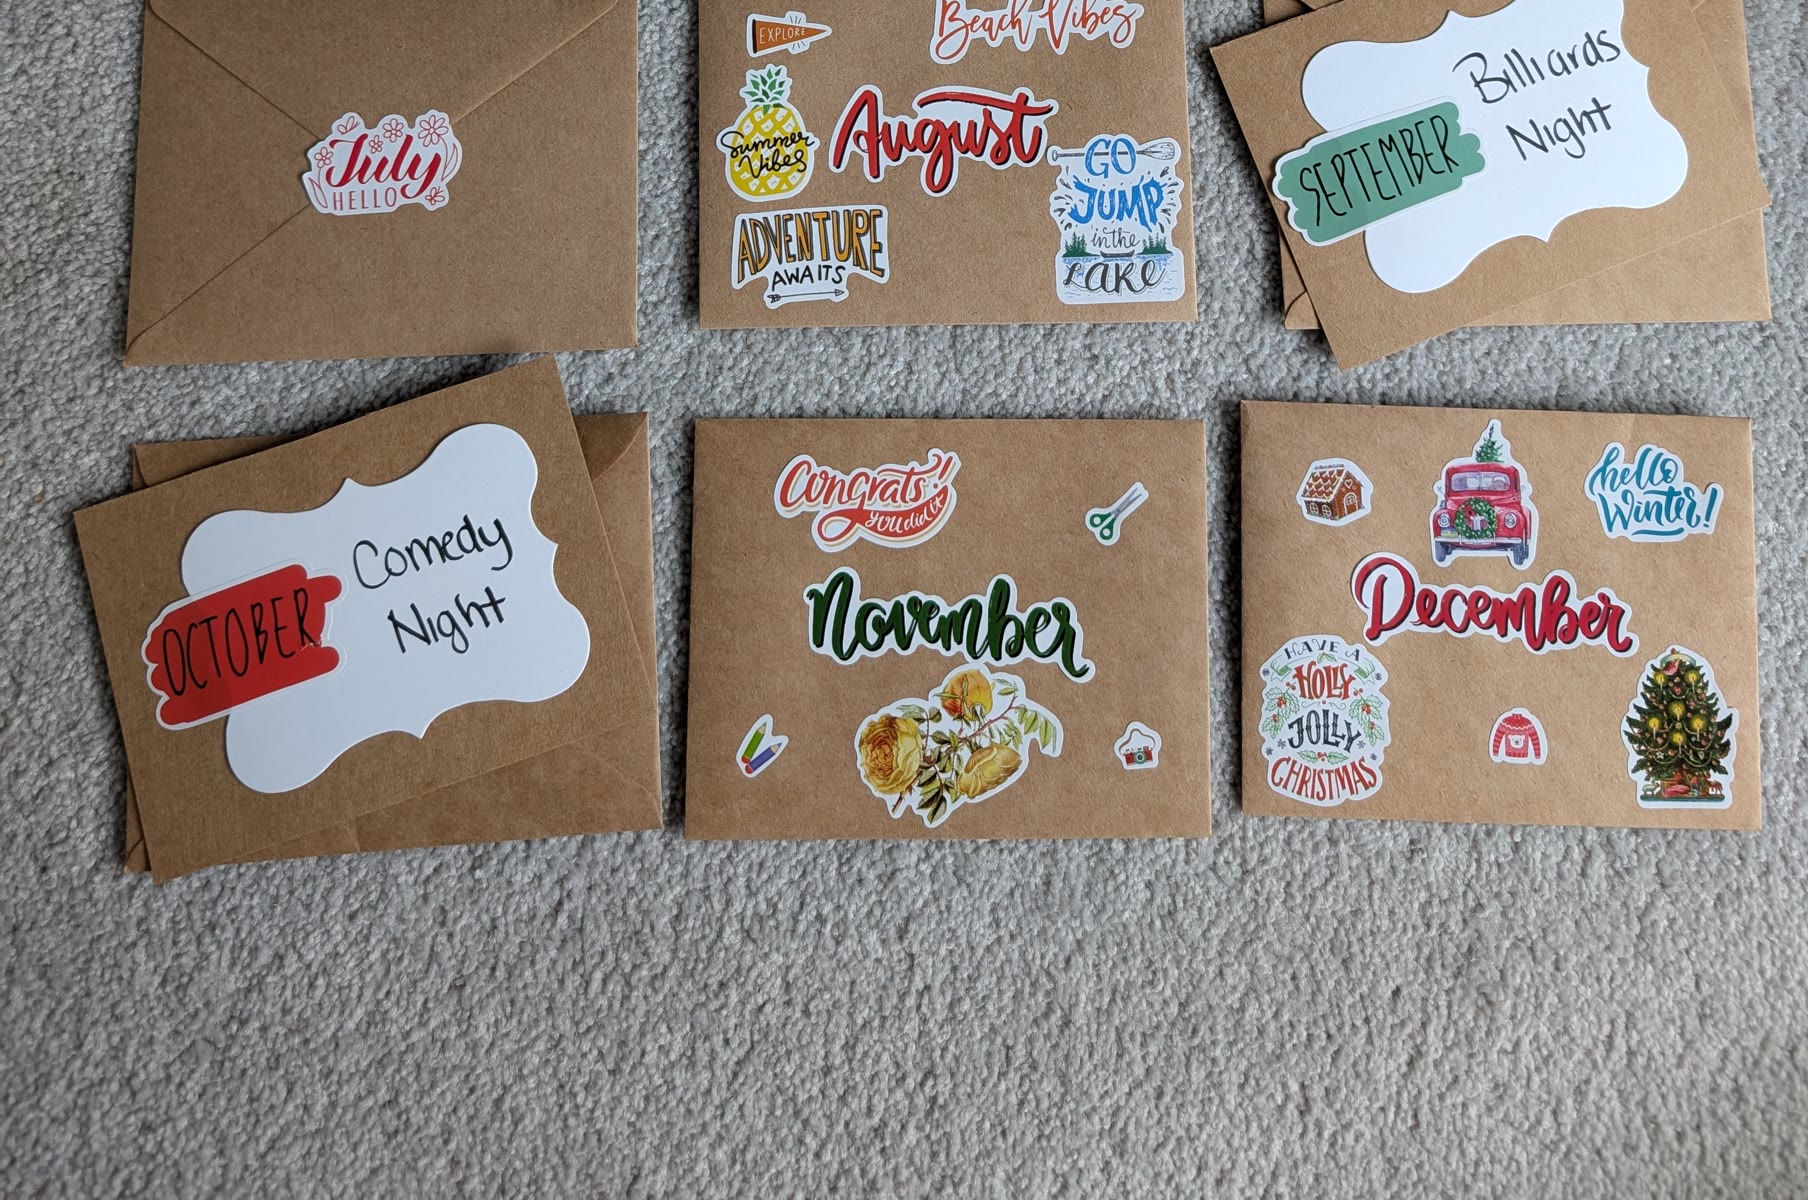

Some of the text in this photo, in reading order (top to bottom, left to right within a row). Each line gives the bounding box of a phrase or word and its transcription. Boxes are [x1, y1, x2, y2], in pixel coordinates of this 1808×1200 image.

[759, 27, 806, 45] EXPLORE
[1453, 30, 1620, 104] Billiards
[720, 130, 815, 159] Summer
[833, 90, 1054, 193] August
[1506, 97, 1612, 160] Night
[326, 133, 442, 199] July
[738, 149, 807, 179] Vibes
[1085, 138, 1137, 179] GO
[1299, 115, 1459, 226] SEPTEMBER
[333, 187, 397, 210] HELLO
[1067, 175, 1168, 232] JUMP
[738, 209, 885, 282] ADVENTURE
[1091, 227, 1140, 249] in the
[771, 264, 846, 291] AWAITS
[1589, 447, 1678, 493] hello
[865, 494, 944, 533] you did it
[353, 515, 513, 589] Comedy
[387, 586, 506, 653] Night
[807, 571, 1090, 677] November
[1355, 557, 1633, 652] December
[162, 587, 319, 695] OCTOBER
[1284, 638, 1360, 661] HAVE A
[1293, 660, 1356, 700] HOLLY
[1287, 709, 1361, 753] JOLLY
[1271, 756, 1377, 801] CHRISTMAS
